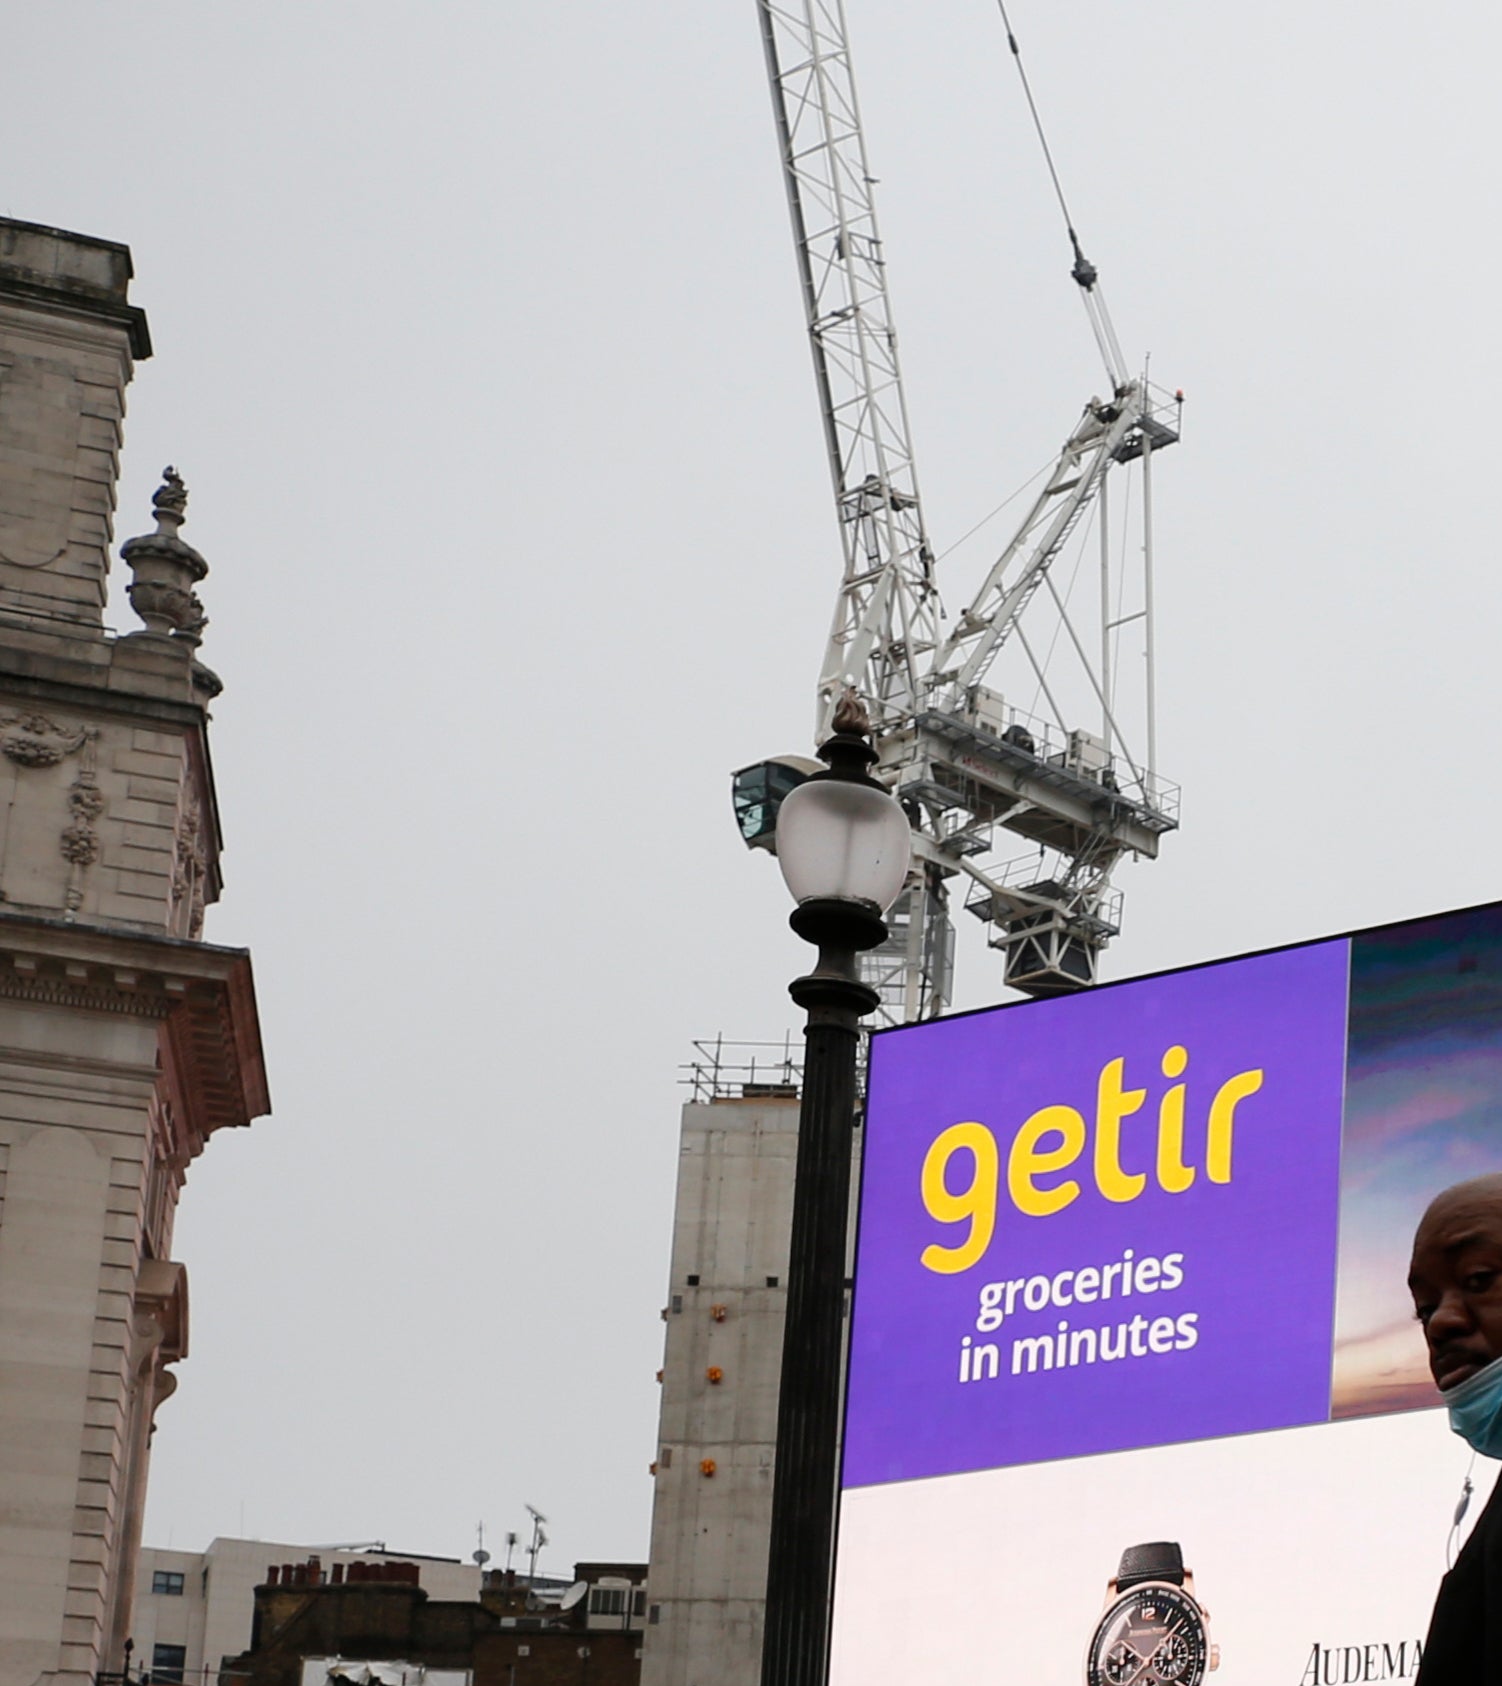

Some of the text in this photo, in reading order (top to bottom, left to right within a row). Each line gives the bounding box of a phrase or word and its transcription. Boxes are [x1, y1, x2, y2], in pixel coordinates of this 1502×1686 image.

[920, 1044, 1263, 1275] getir
[976, 1248, 1185, 1332] groceries
[958, 1311, 1199, 1383] in minutes
